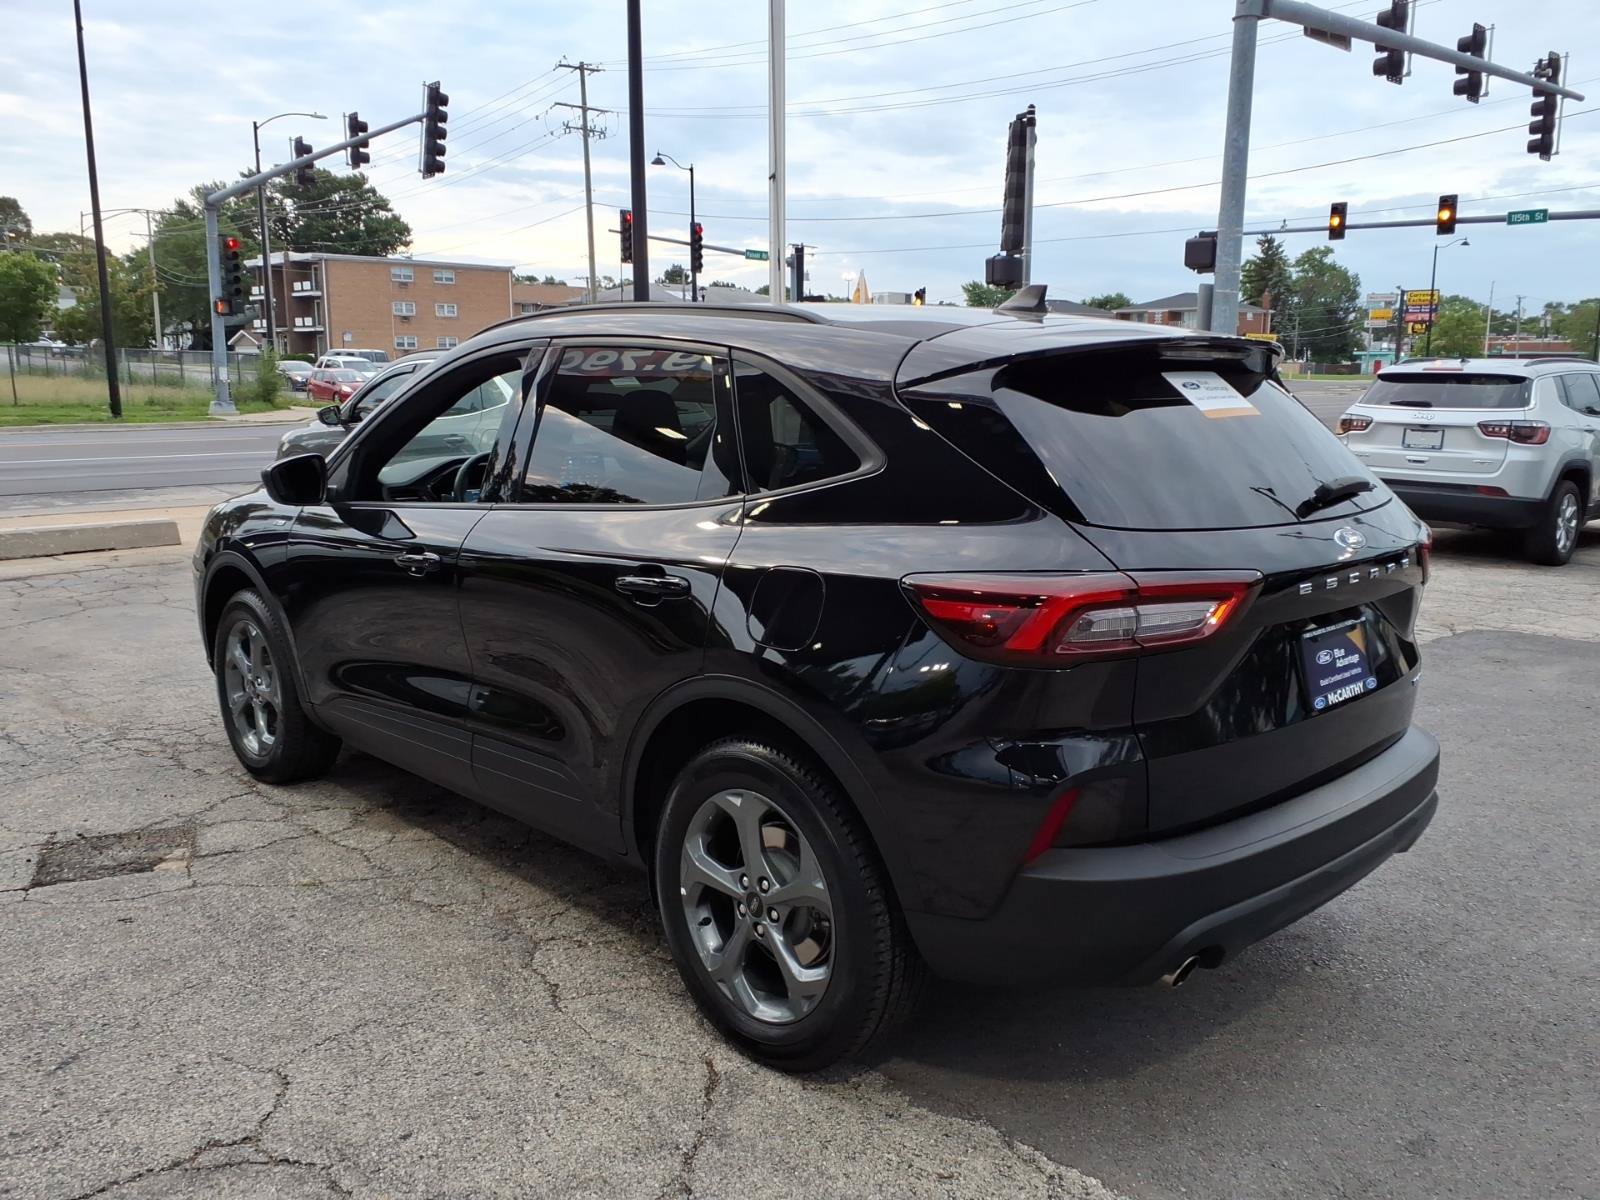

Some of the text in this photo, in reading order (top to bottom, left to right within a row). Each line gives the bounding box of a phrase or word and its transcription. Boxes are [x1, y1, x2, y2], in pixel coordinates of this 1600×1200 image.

[1511, 212, 1544, 222] 115th St
[1299, 558, 1410, 595] ESCAPE
[1333, 647, 1345, 658] Blue
[1336, 653, 1360, 668] Advantage
[1327, 680, 1365, 706] McCARTHY
